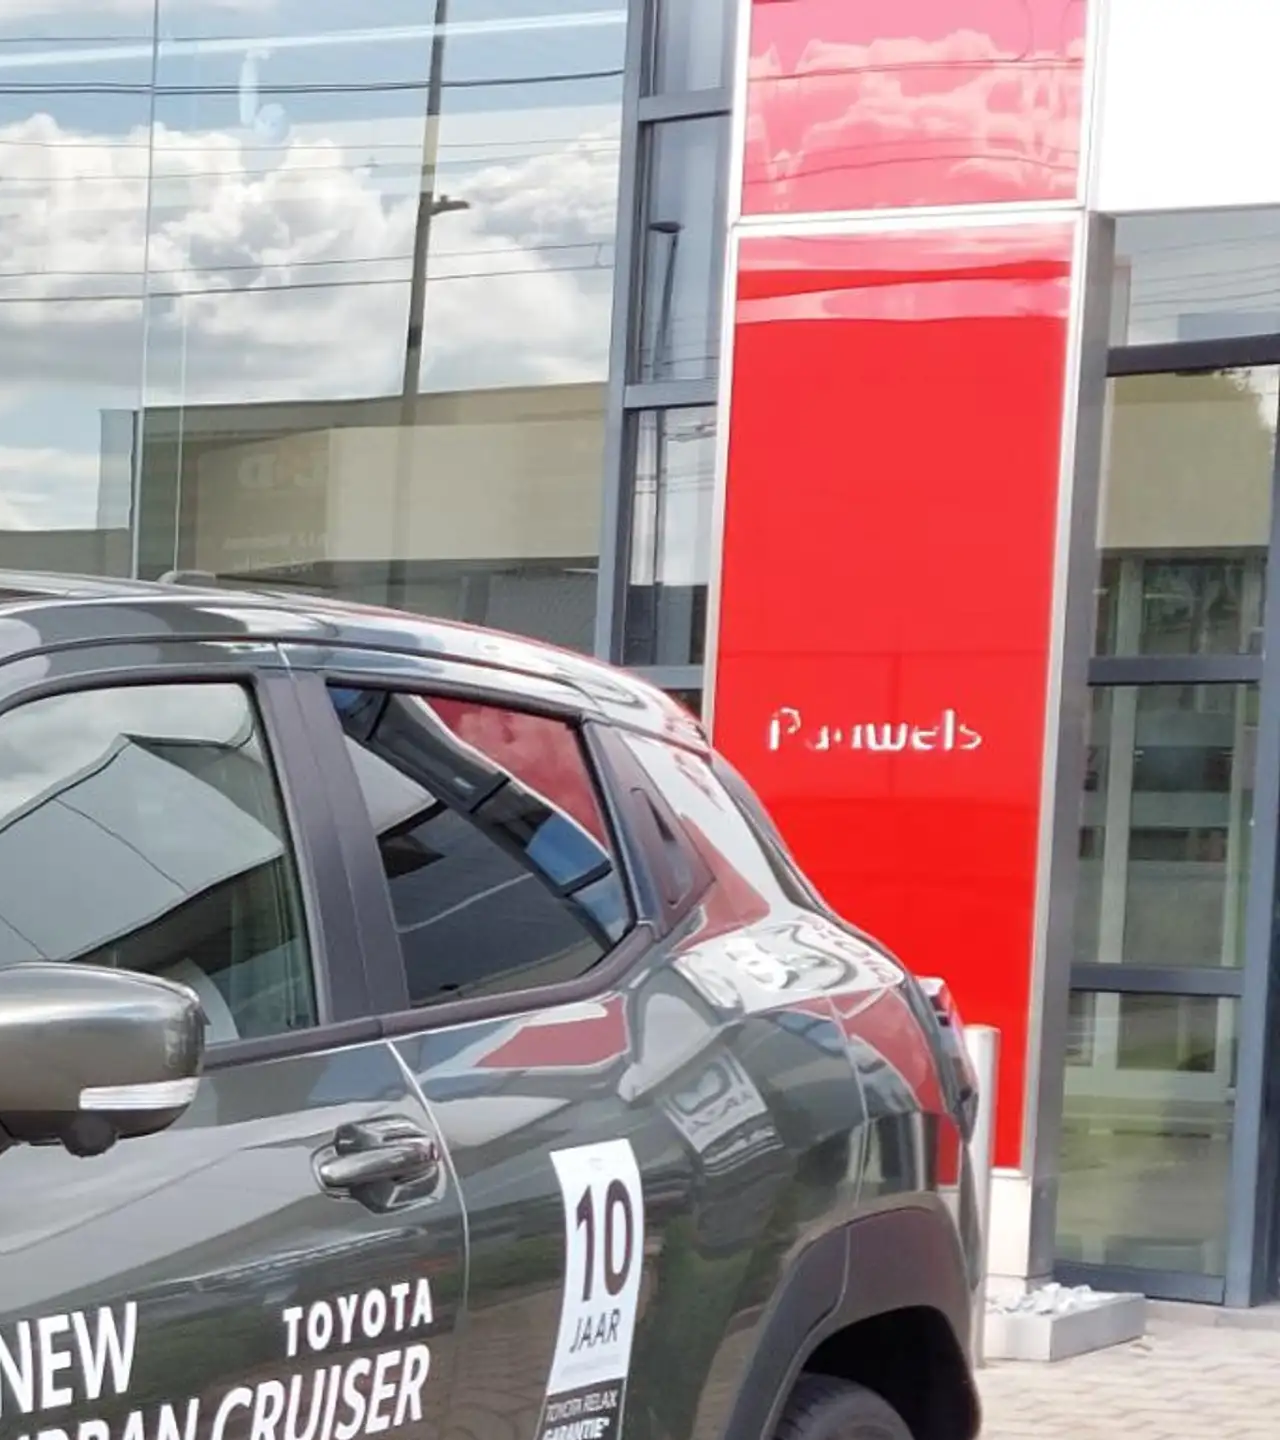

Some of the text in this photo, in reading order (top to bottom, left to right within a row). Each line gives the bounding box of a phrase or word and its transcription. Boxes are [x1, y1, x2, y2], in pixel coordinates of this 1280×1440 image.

[576, 1178, 634, 1301] 10
[283, 1278, 433, 1358] TOYOTA
[570, 1307, 622, 1354] JAAR
